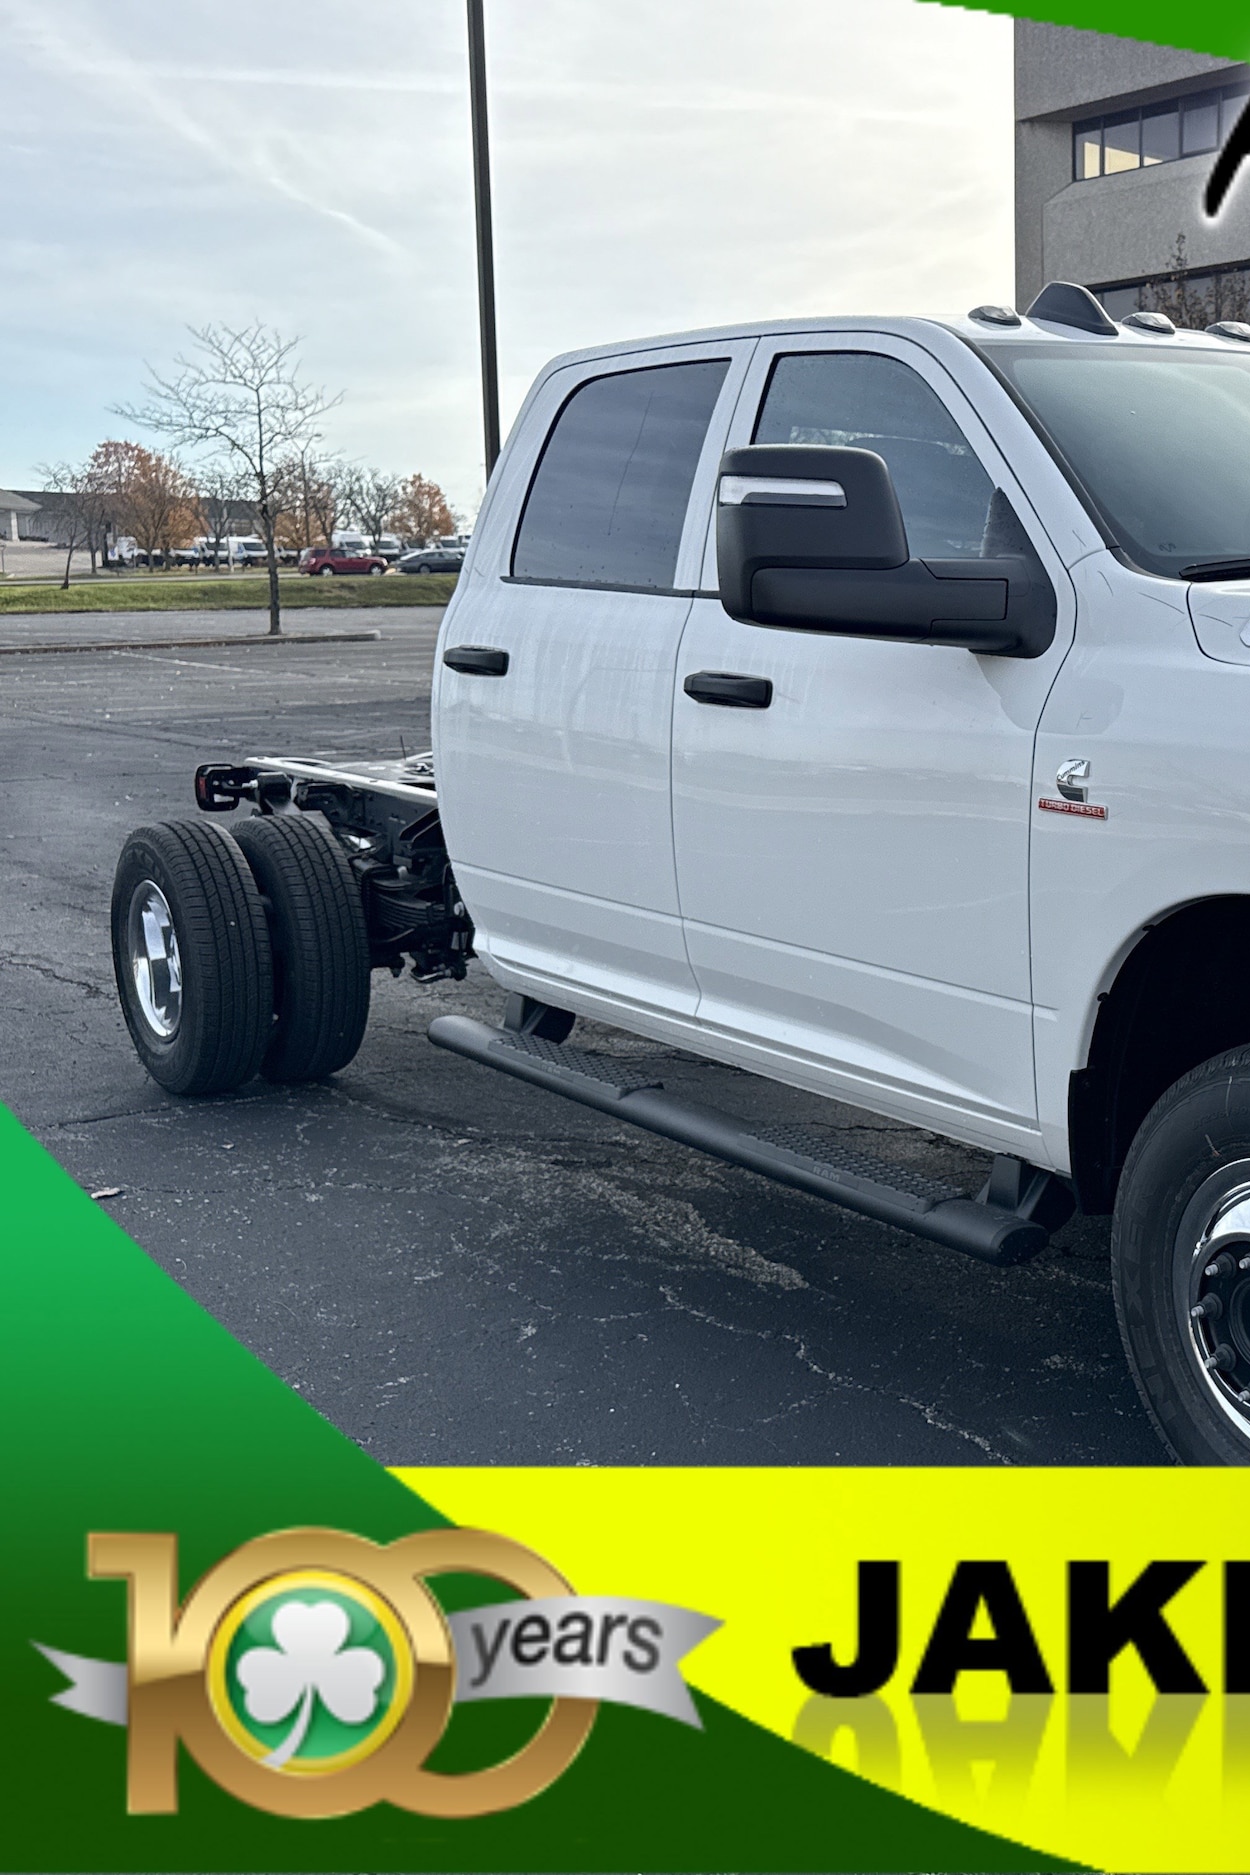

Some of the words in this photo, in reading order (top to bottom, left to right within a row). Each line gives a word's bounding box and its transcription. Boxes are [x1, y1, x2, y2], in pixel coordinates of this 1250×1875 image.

[1040, 799, 1069, 811] TURBO
[1070, 804, 1105, 817] DIESEL
[812, 1165, 841, 1183] RAM
